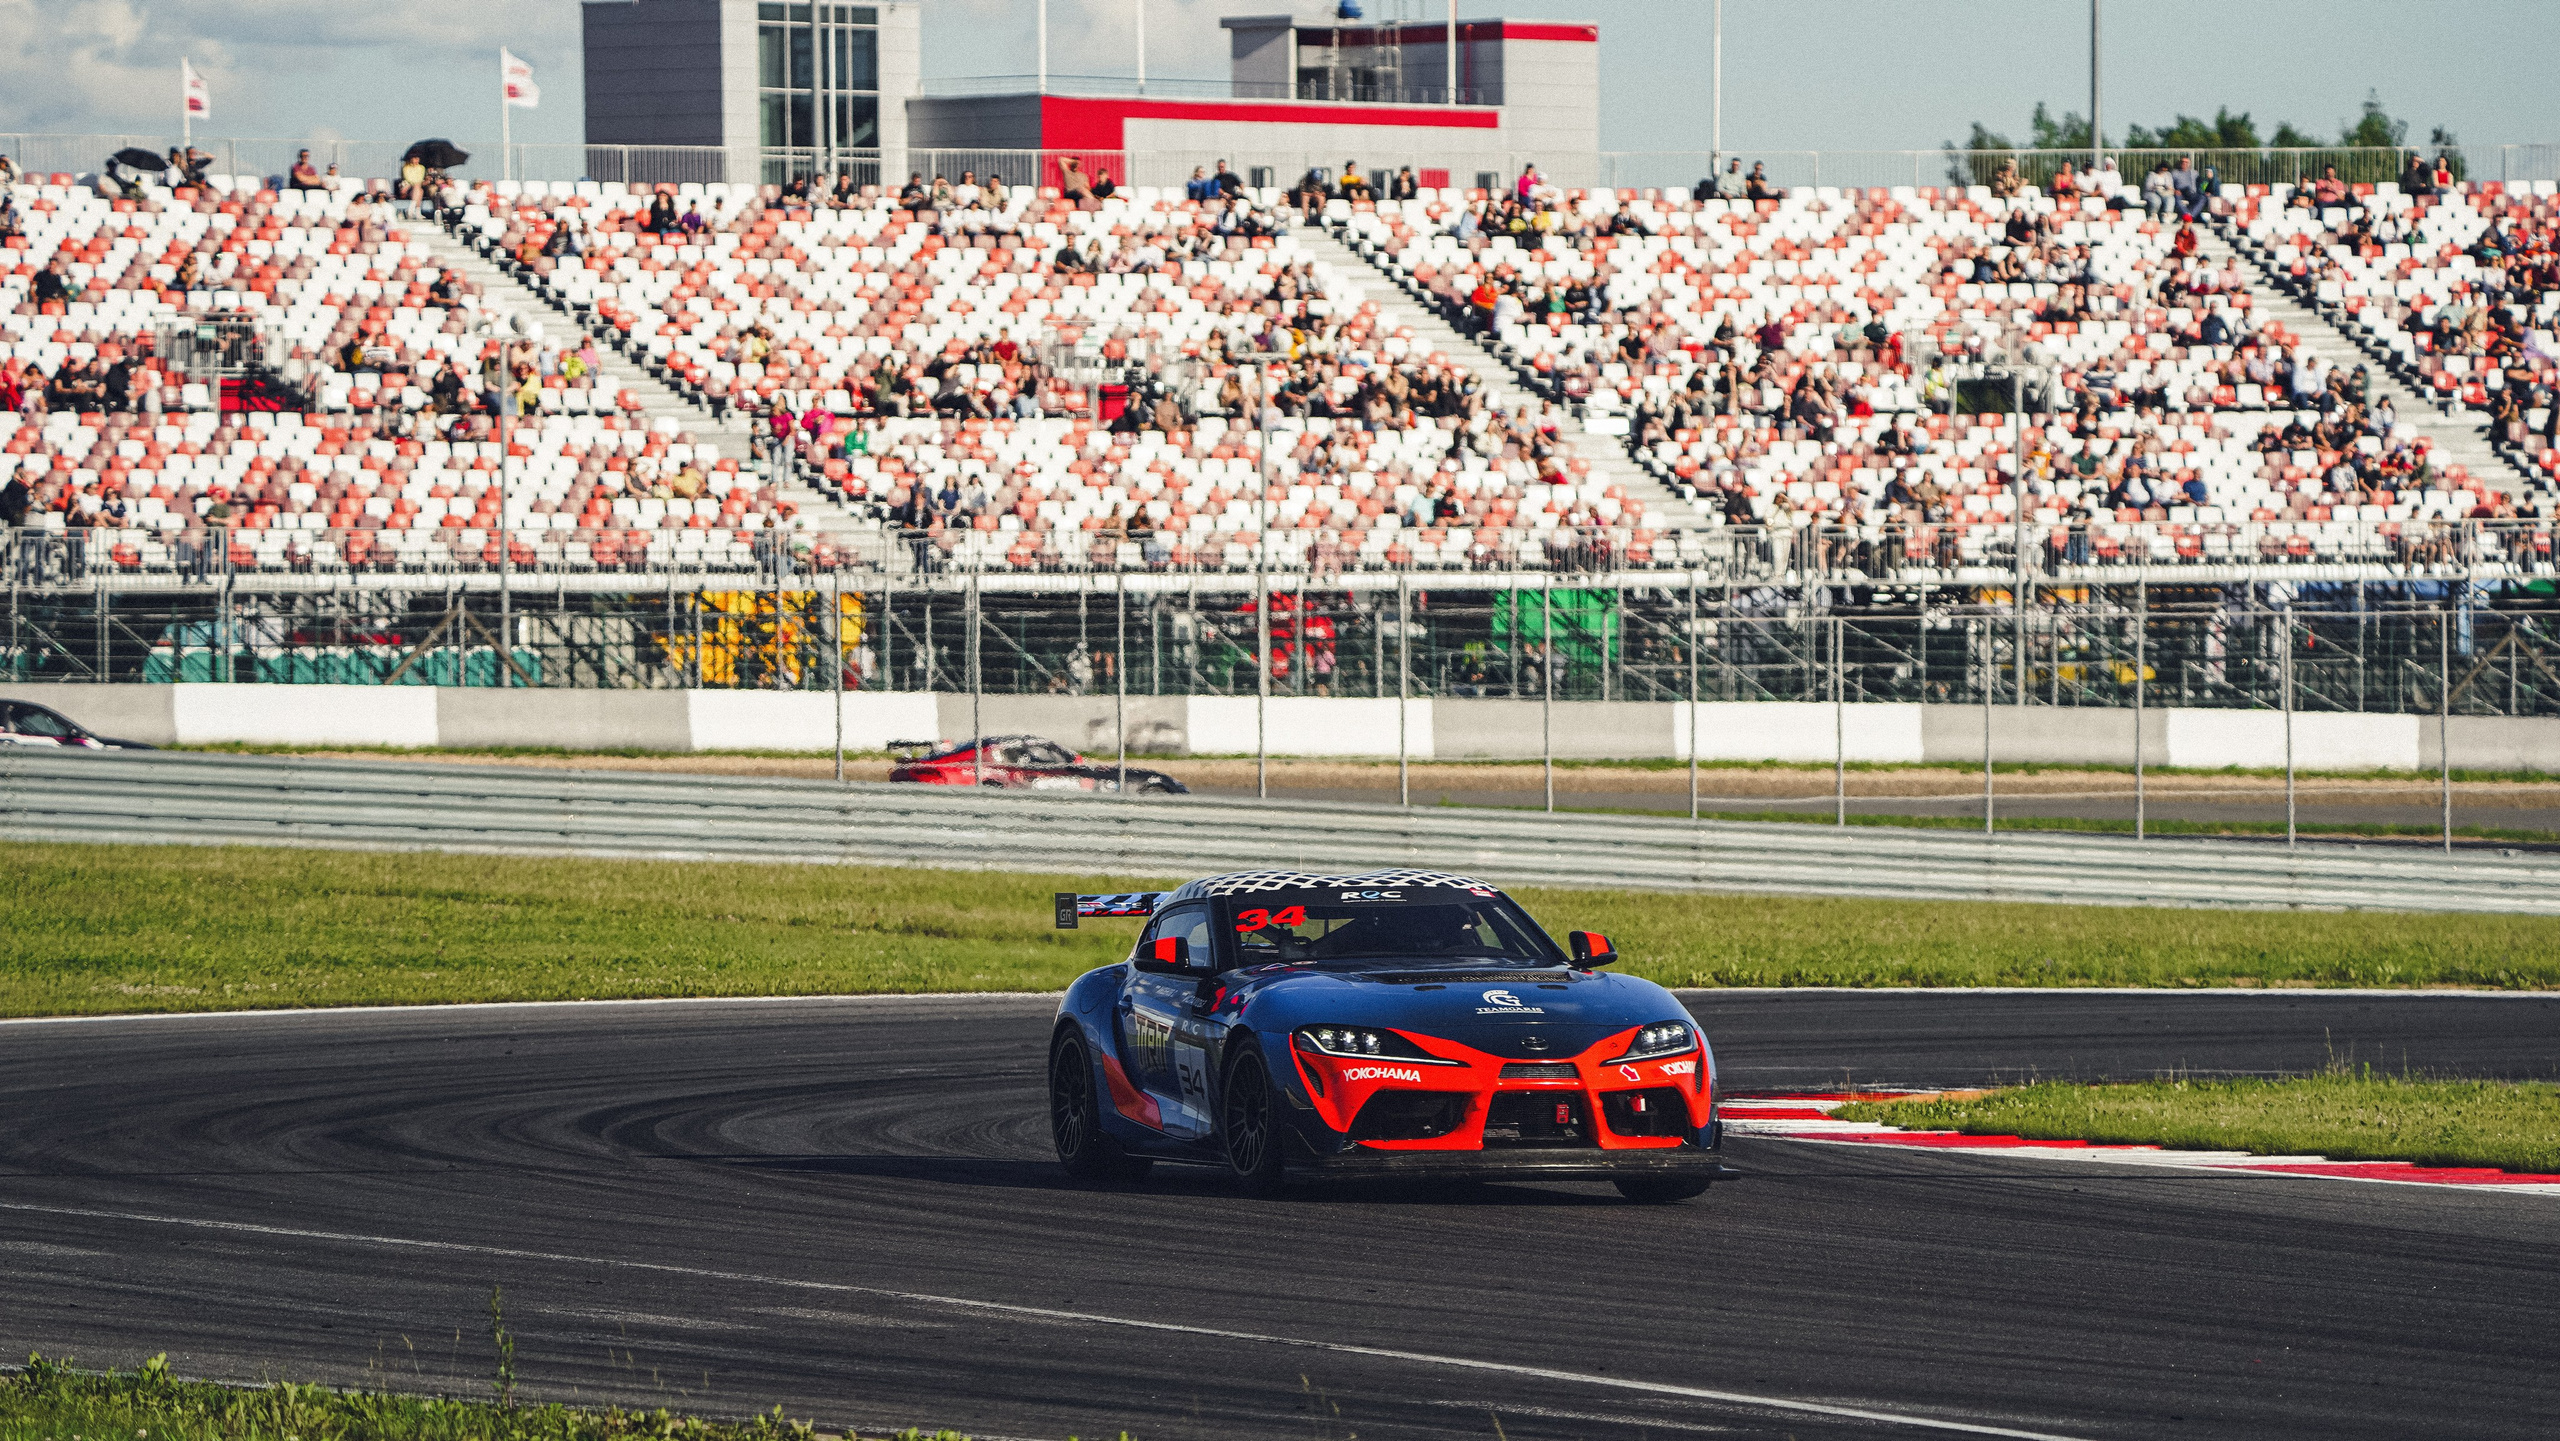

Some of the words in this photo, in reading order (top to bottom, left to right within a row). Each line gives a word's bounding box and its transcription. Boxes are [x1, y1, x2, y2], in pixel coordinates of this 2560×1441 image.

[1236, 905, 1306, 932] 34
[1179, 1063, 1205, 1100] 34
[1343, 1067, 1421, 1082] YOKOHAMA
